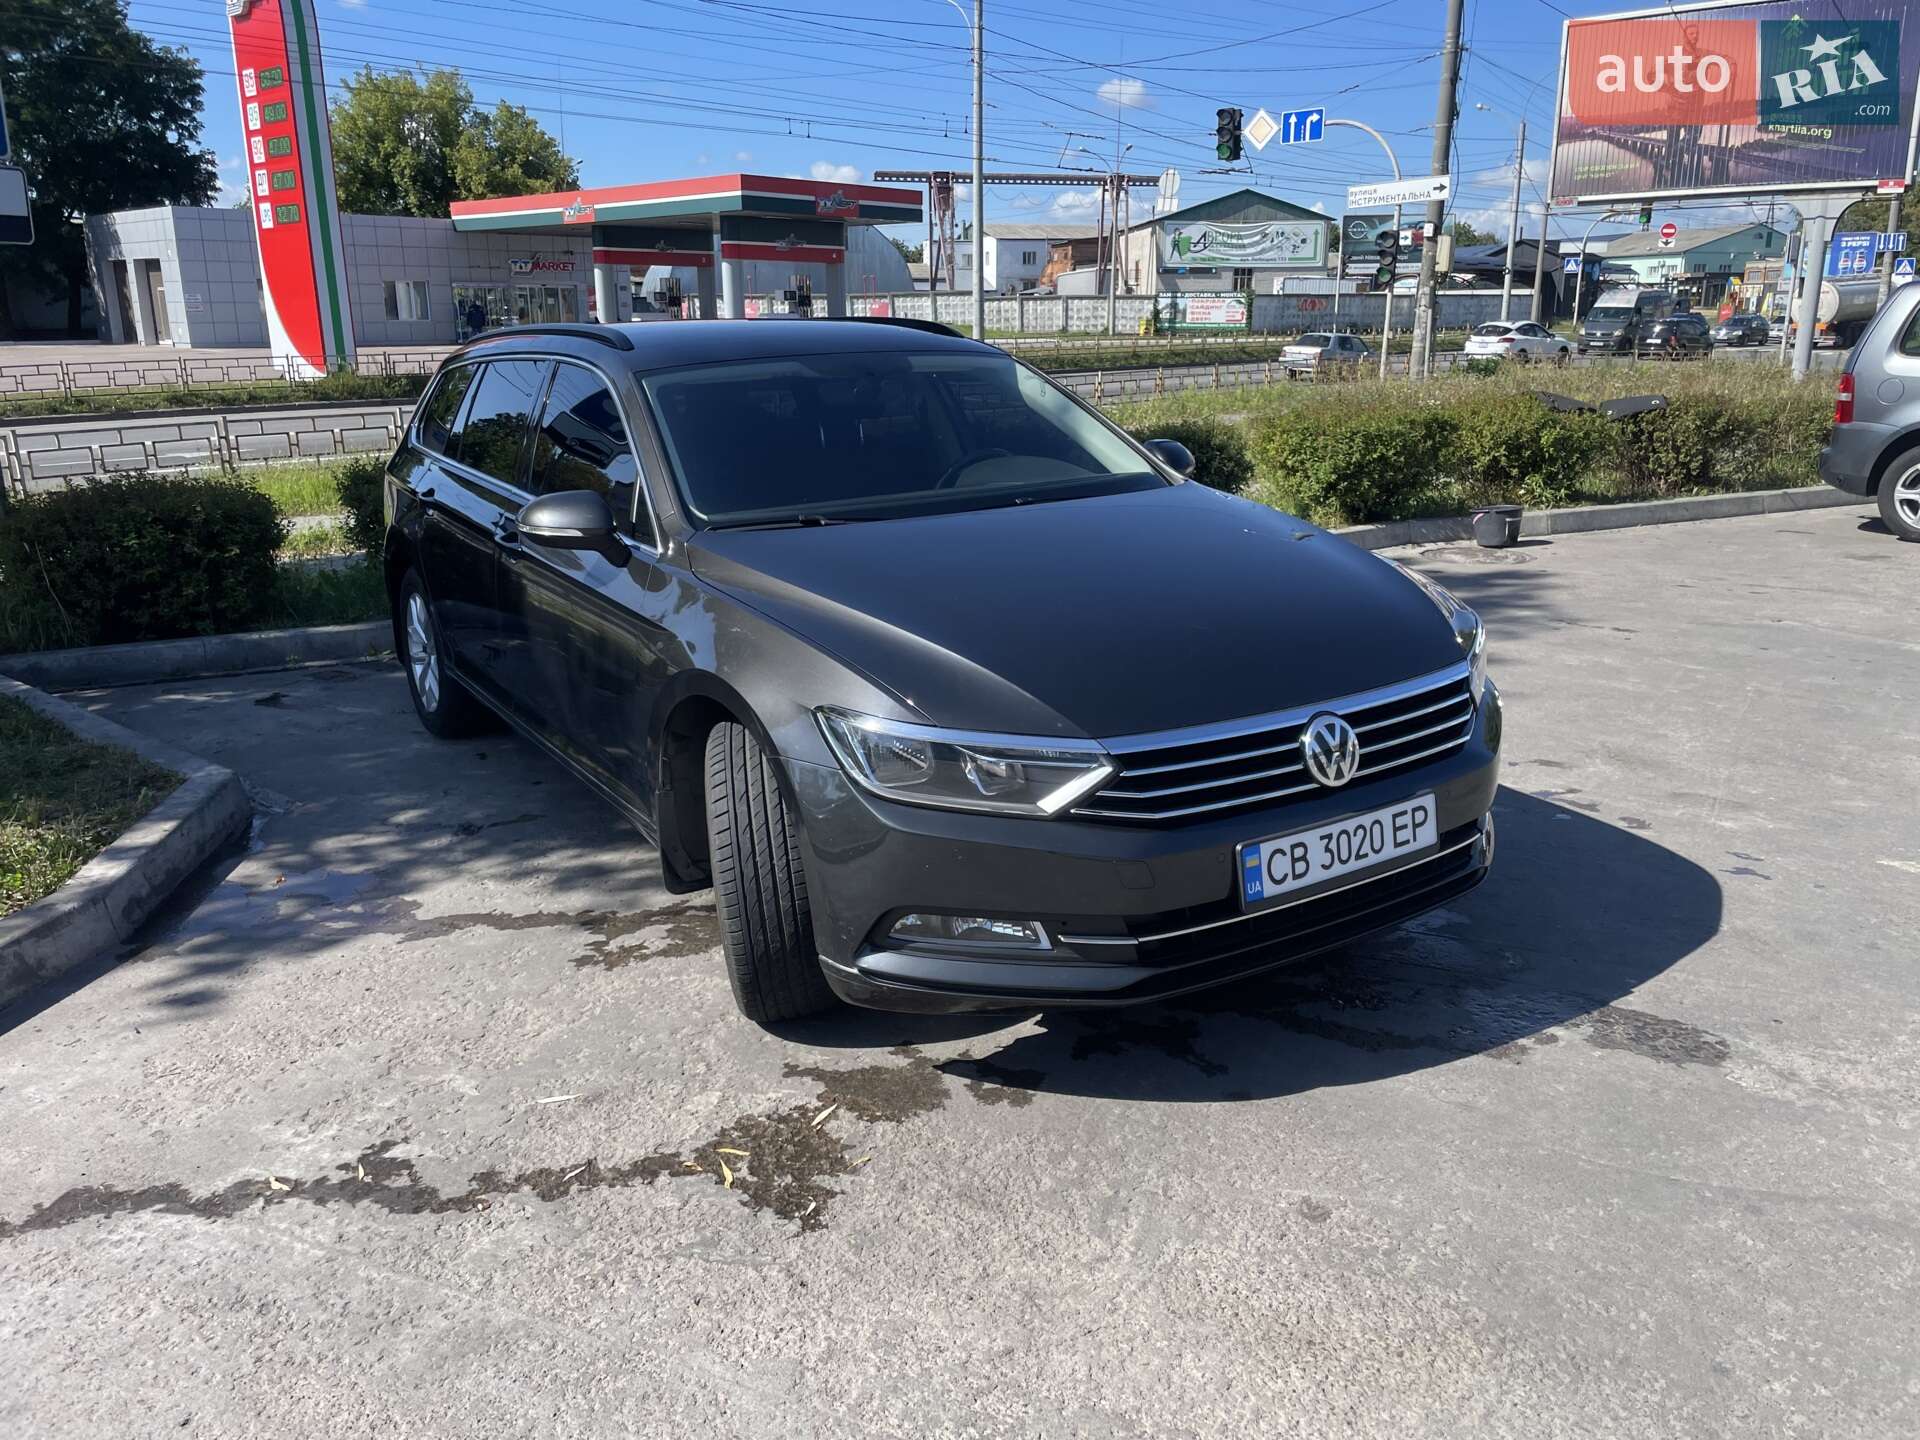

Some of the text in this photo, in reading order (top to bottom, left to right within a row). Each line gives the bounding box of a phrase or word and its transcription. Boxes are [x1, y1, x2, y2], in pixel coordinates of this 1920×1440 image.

[248, 106, 258, 121] 95
[531, 262, 576, 272] MARKET
[1319, 818, 1385, 871] 3020
[1247, 881, 1262, 894] UA
